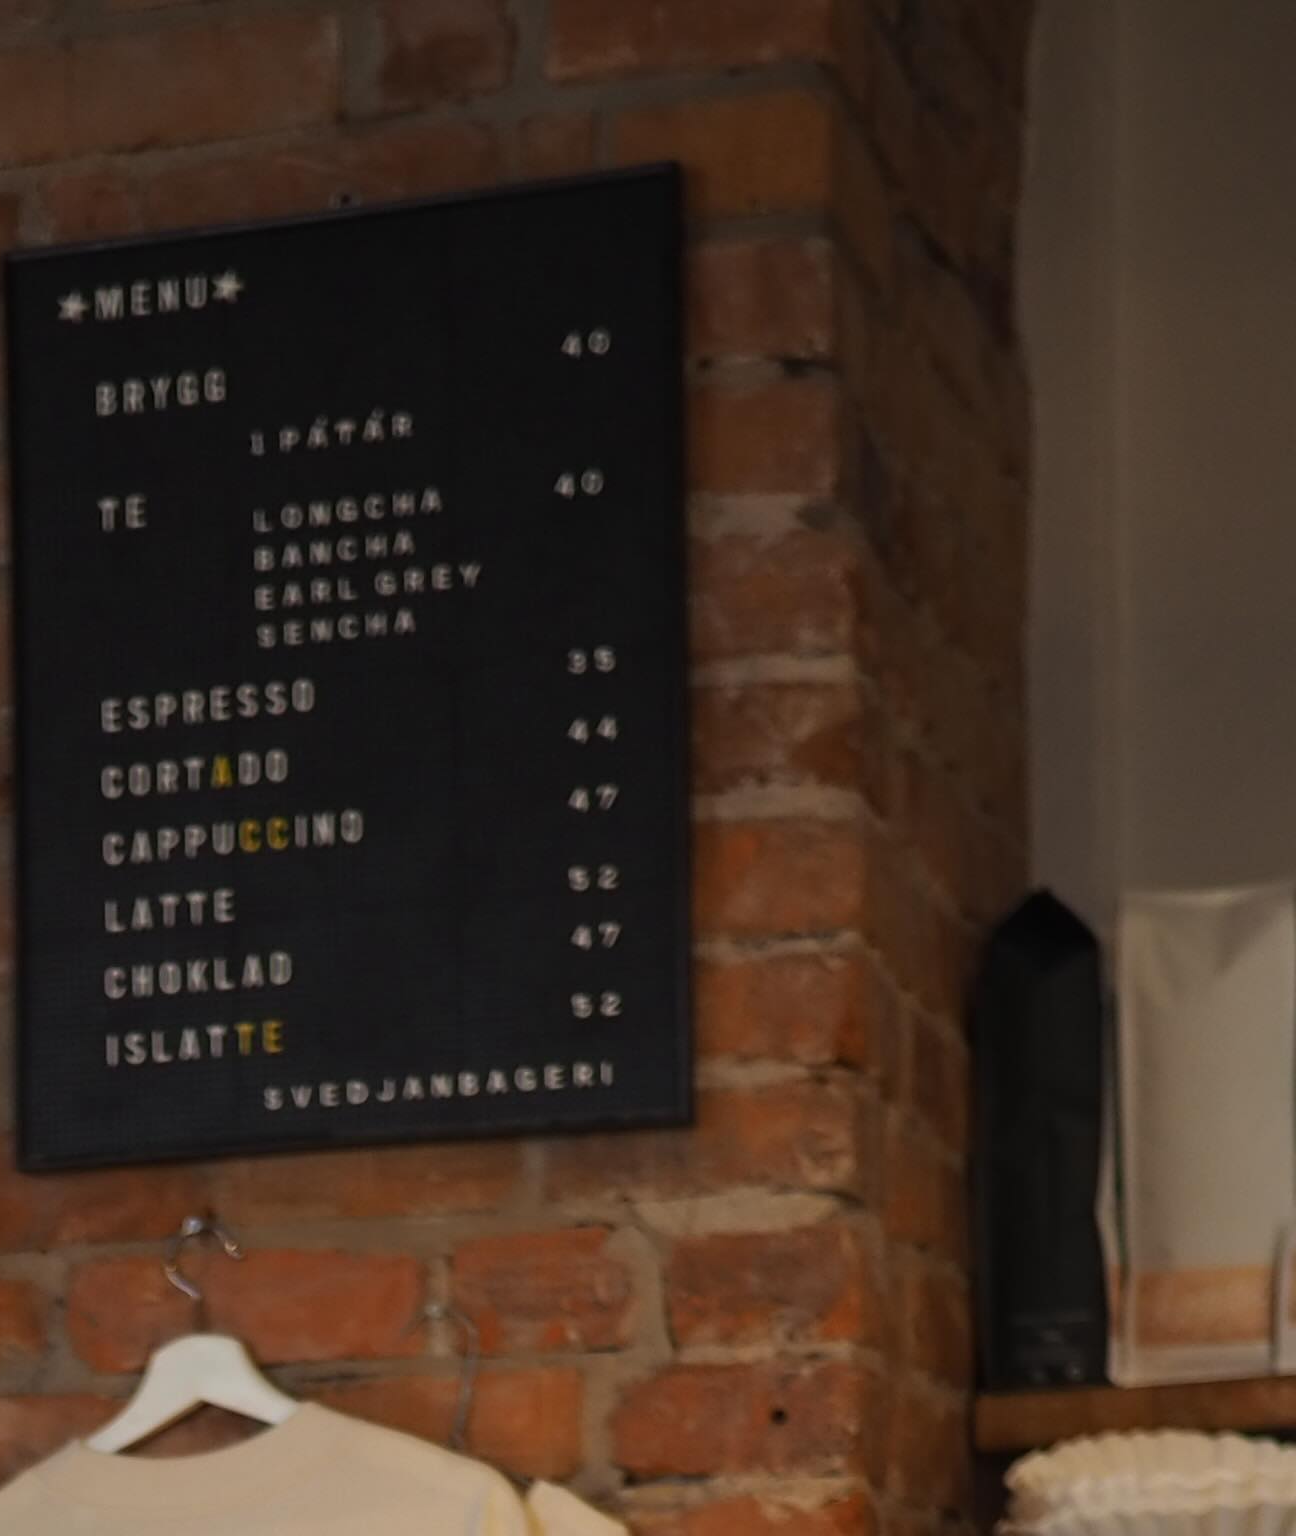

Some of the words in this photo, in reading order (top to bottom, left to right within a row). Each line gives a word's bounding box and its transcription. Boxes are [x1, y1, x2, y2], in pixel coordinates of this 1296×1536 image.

[94, 274, 208, 320] MENU
[95, 369, 226, 416] BRYGG
[562, 329, 611, 358] 40
[98, 494, 146, 532] TE
[253, 487, 442, 532] LONGCHA
[554, 470, 603, 499] 40
[253, 530, 415, 571] BANCHA
[254, 577, 358, 610] EARL
[374, 563, 482, 597] GREY
[257, 608, 416, 648] SENCHA
[101, 679, 315, 733] ESPRESSO
[567, 646, 616, 674] 35
[101, 749, 288, 798] CORTADO
[568, 716, 618, 744] 44
[102, 809, 364, 866] CAPPUCCINO
[568, 785, 618, 813] 47
[104, 888, 236, 932] LATTE
[567, 865, 619, 891] 52
[104, 951, 292, 999] CHOKLAD
[571, 922, 621, 949] 47
[106, 1020, 284, 1066] ISLATTE
[571, 992, 621, 1018] 52
[264, 1062, 614, 1110] SVEDJANBAGERI
